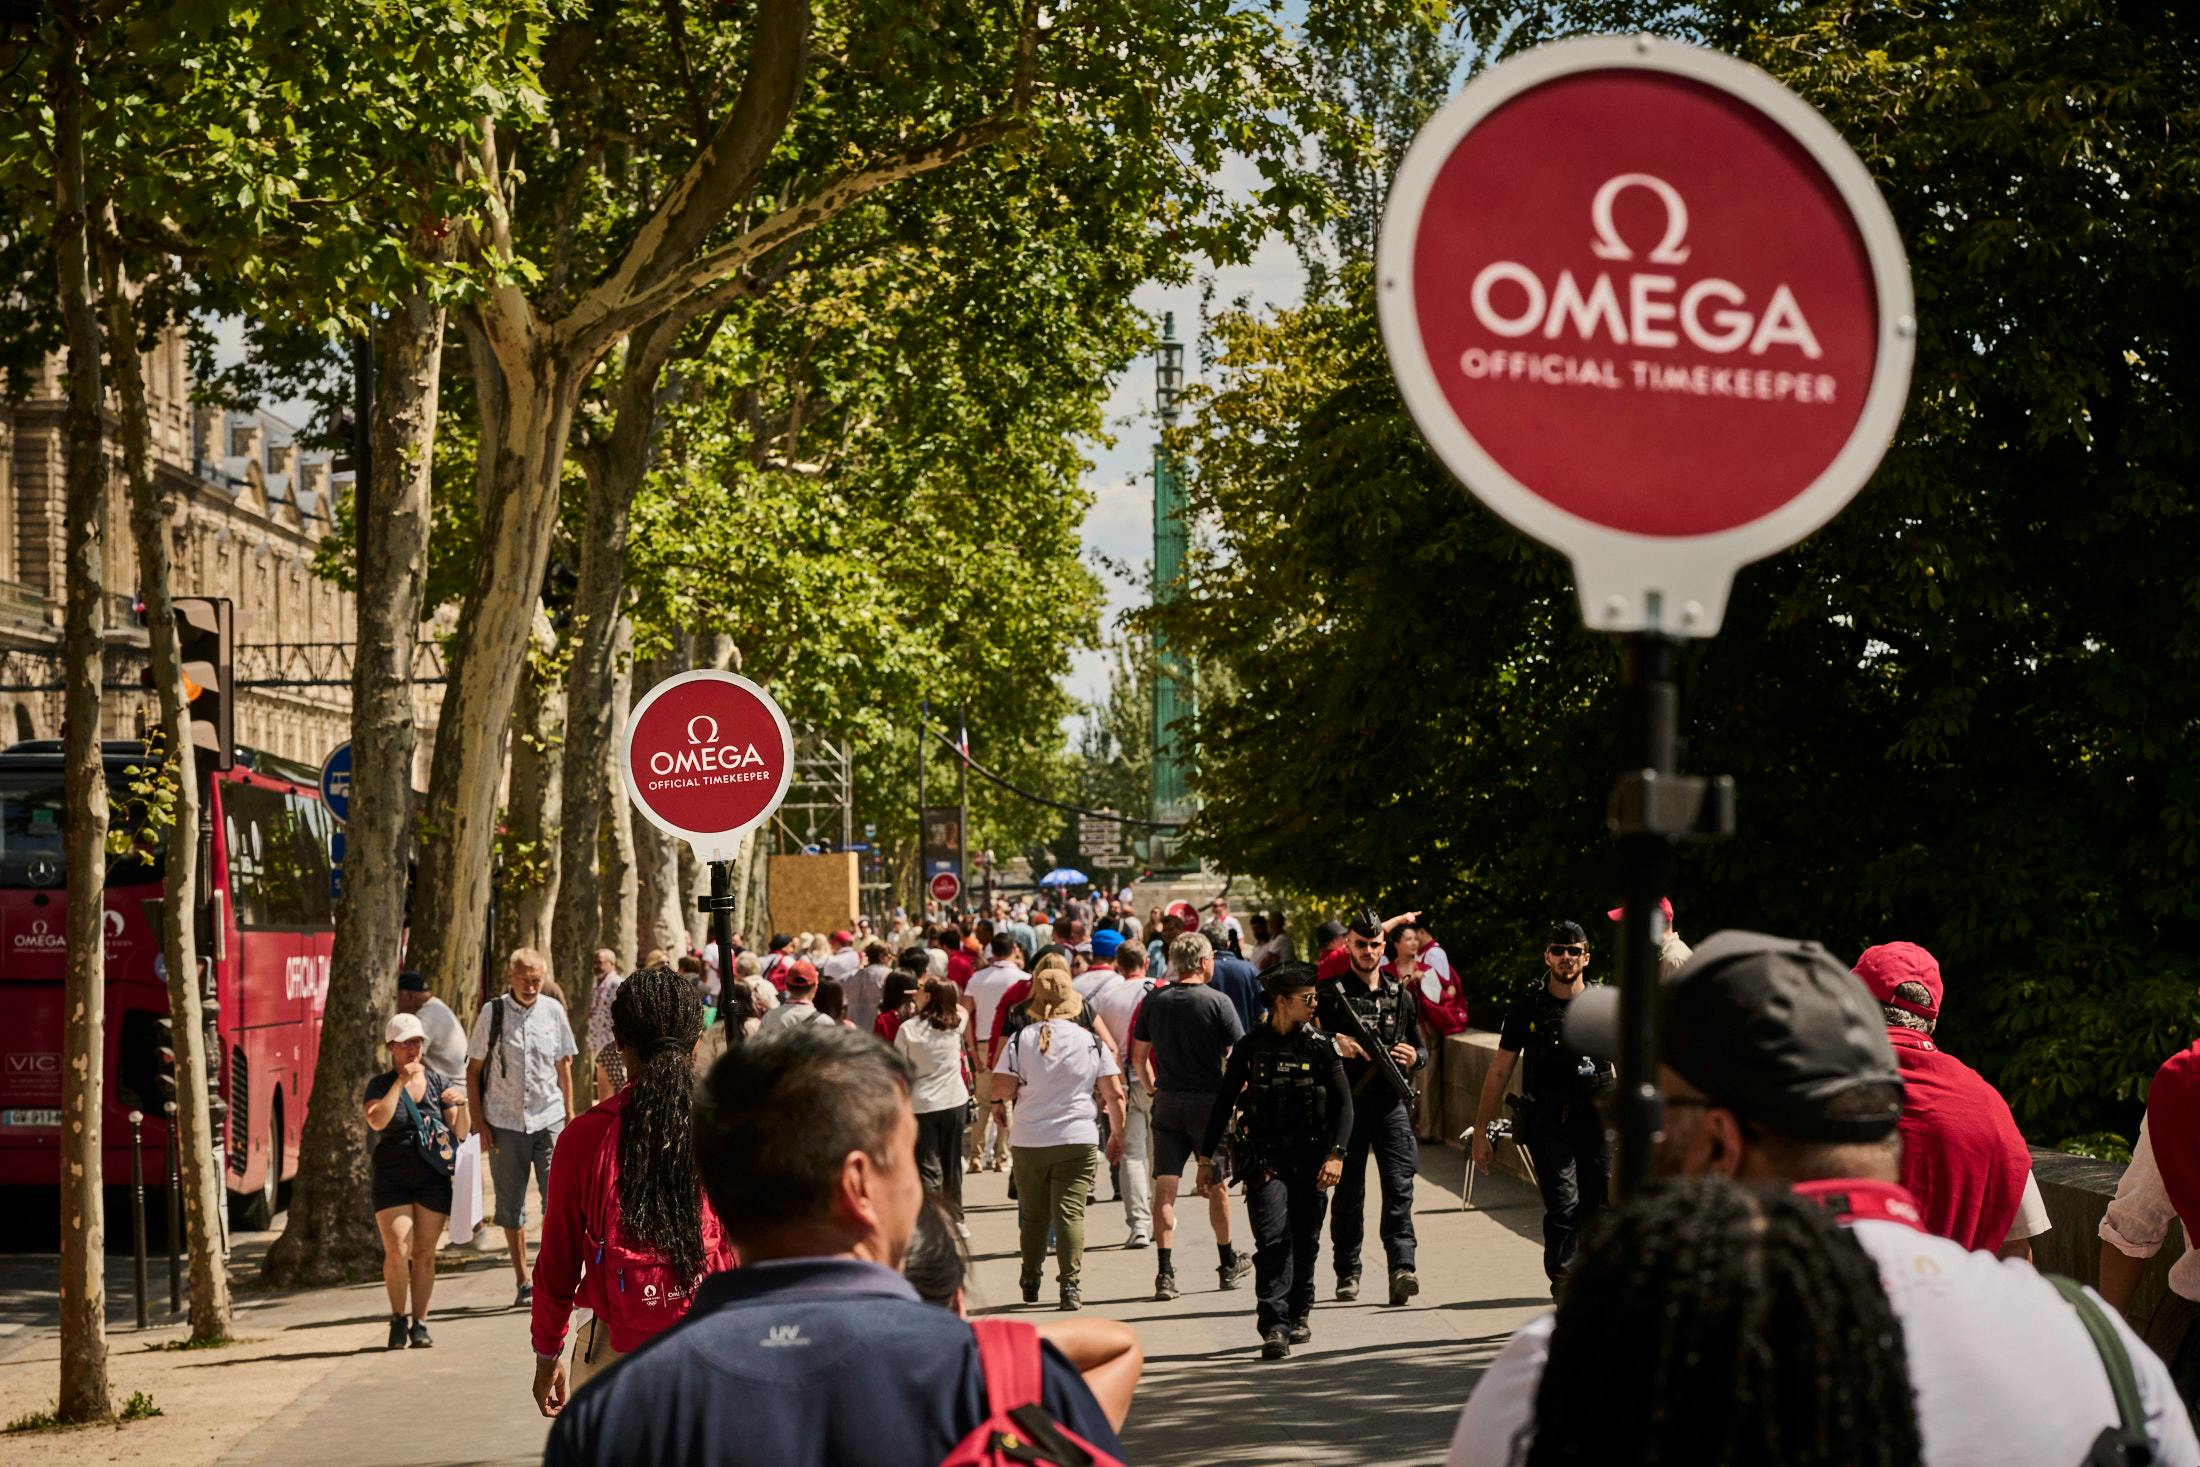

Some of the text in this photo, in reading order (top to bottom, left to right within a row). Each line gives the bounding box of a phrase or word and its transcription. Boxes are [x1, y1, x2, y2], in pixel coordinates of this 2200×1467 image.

[1470, 260, 1823, 360] OMEGA
[1460, 347, 1837, 405] OFFICIAL TIMEKEEPER
[650, 743, 765, 775] OMEGA
[648, 771, 770, 790] OFFICIAL TIMEKEEPER
[14, 934, 66, 947] OMEGA
[10, 1056, 56, 1071] VIC
